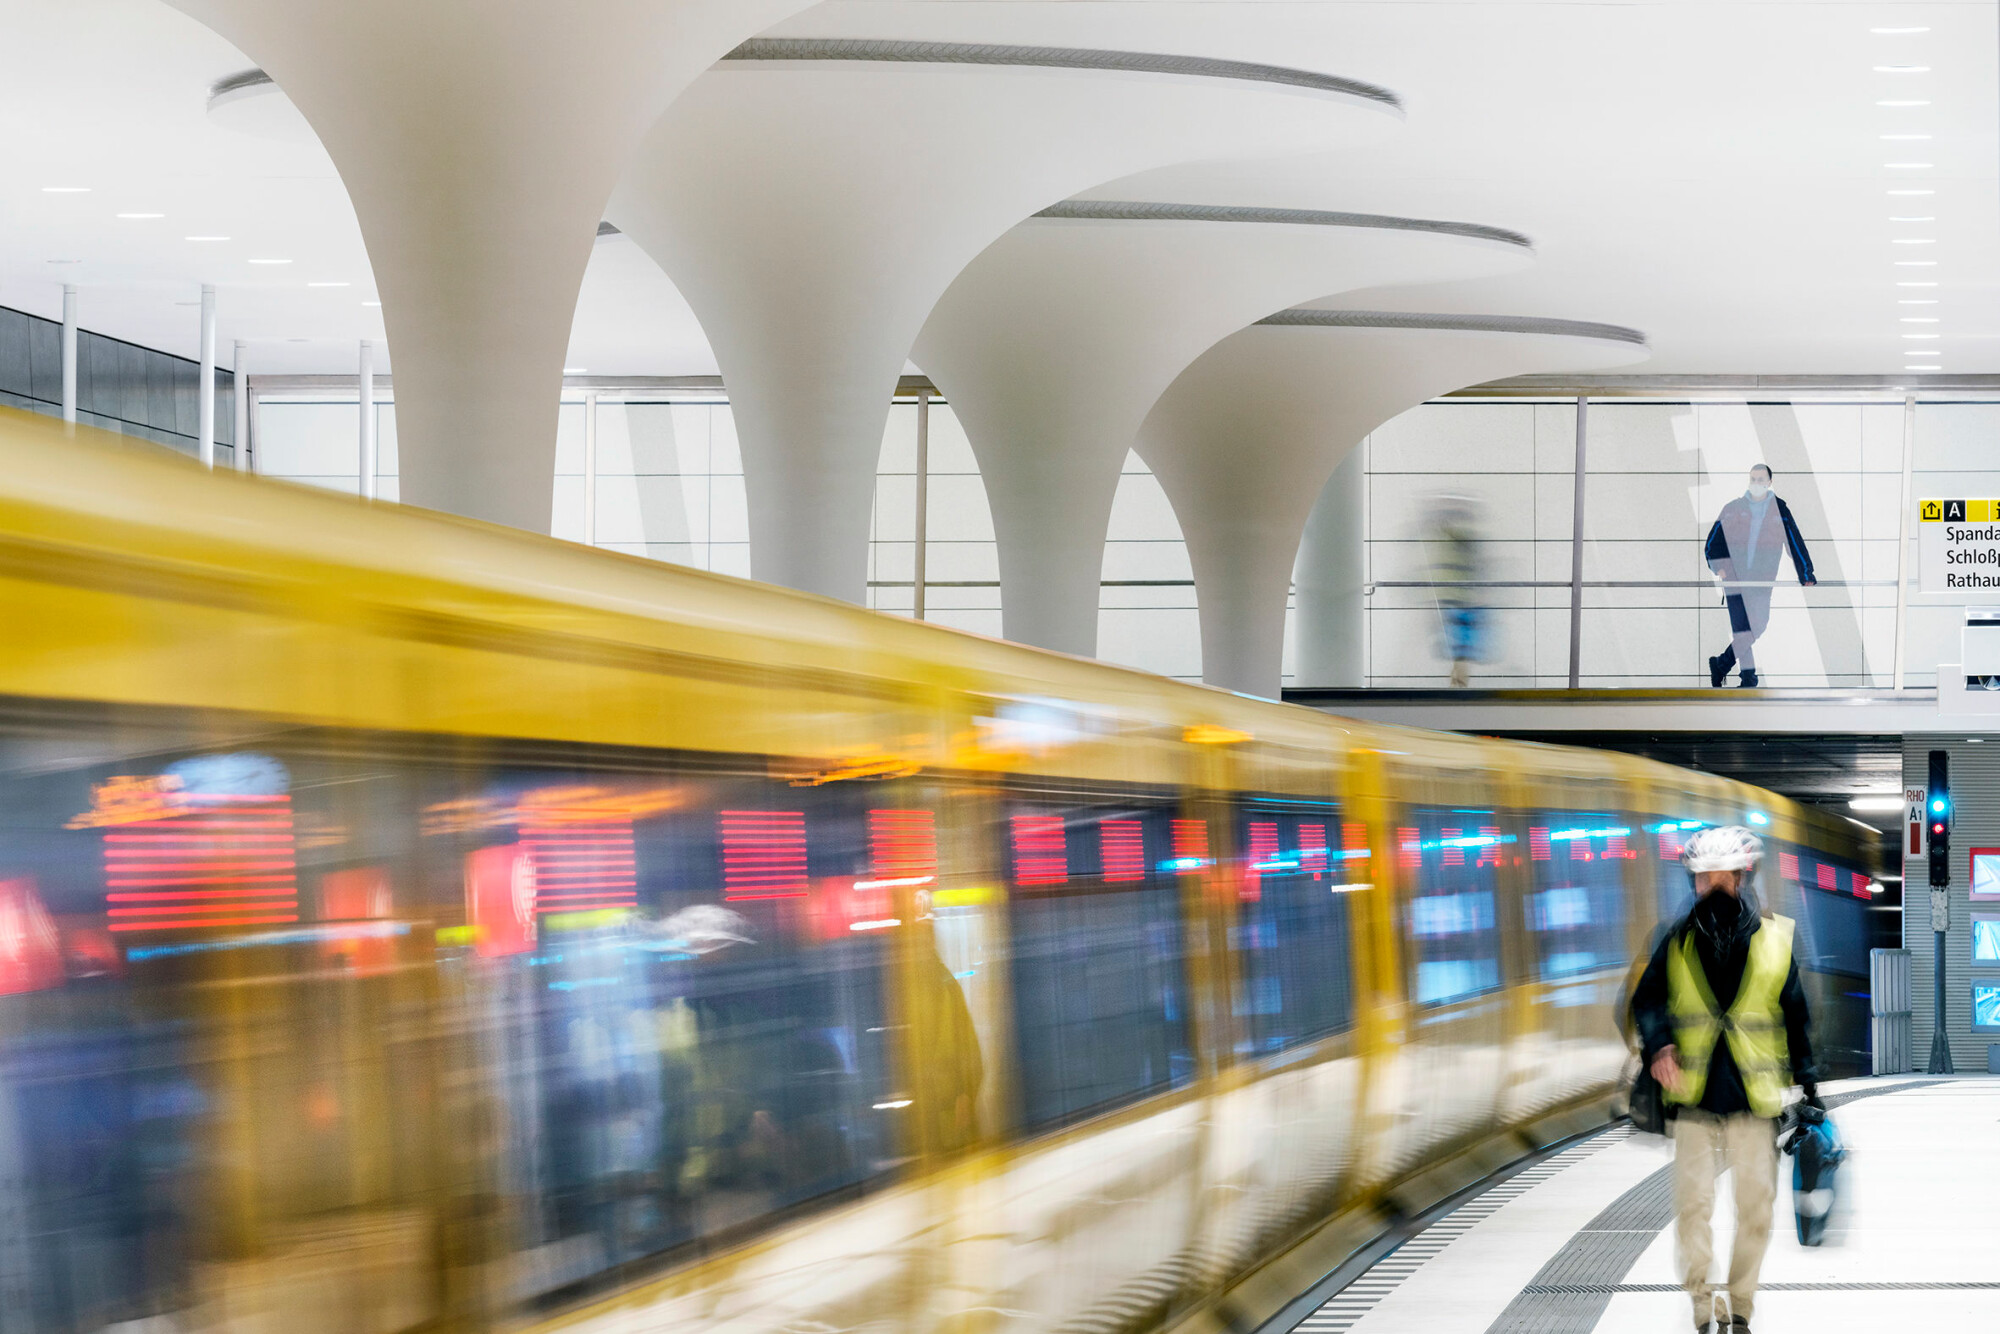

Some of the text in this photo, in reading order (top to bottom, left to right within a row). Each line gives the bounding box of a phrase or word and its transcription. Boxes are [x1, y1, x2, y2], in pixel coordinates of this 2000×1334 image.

[1948, 502, 1961, 517] A
[1946, 548, 2000, 567] Schloß
[1947, 572, 2000, 587] Rathau
